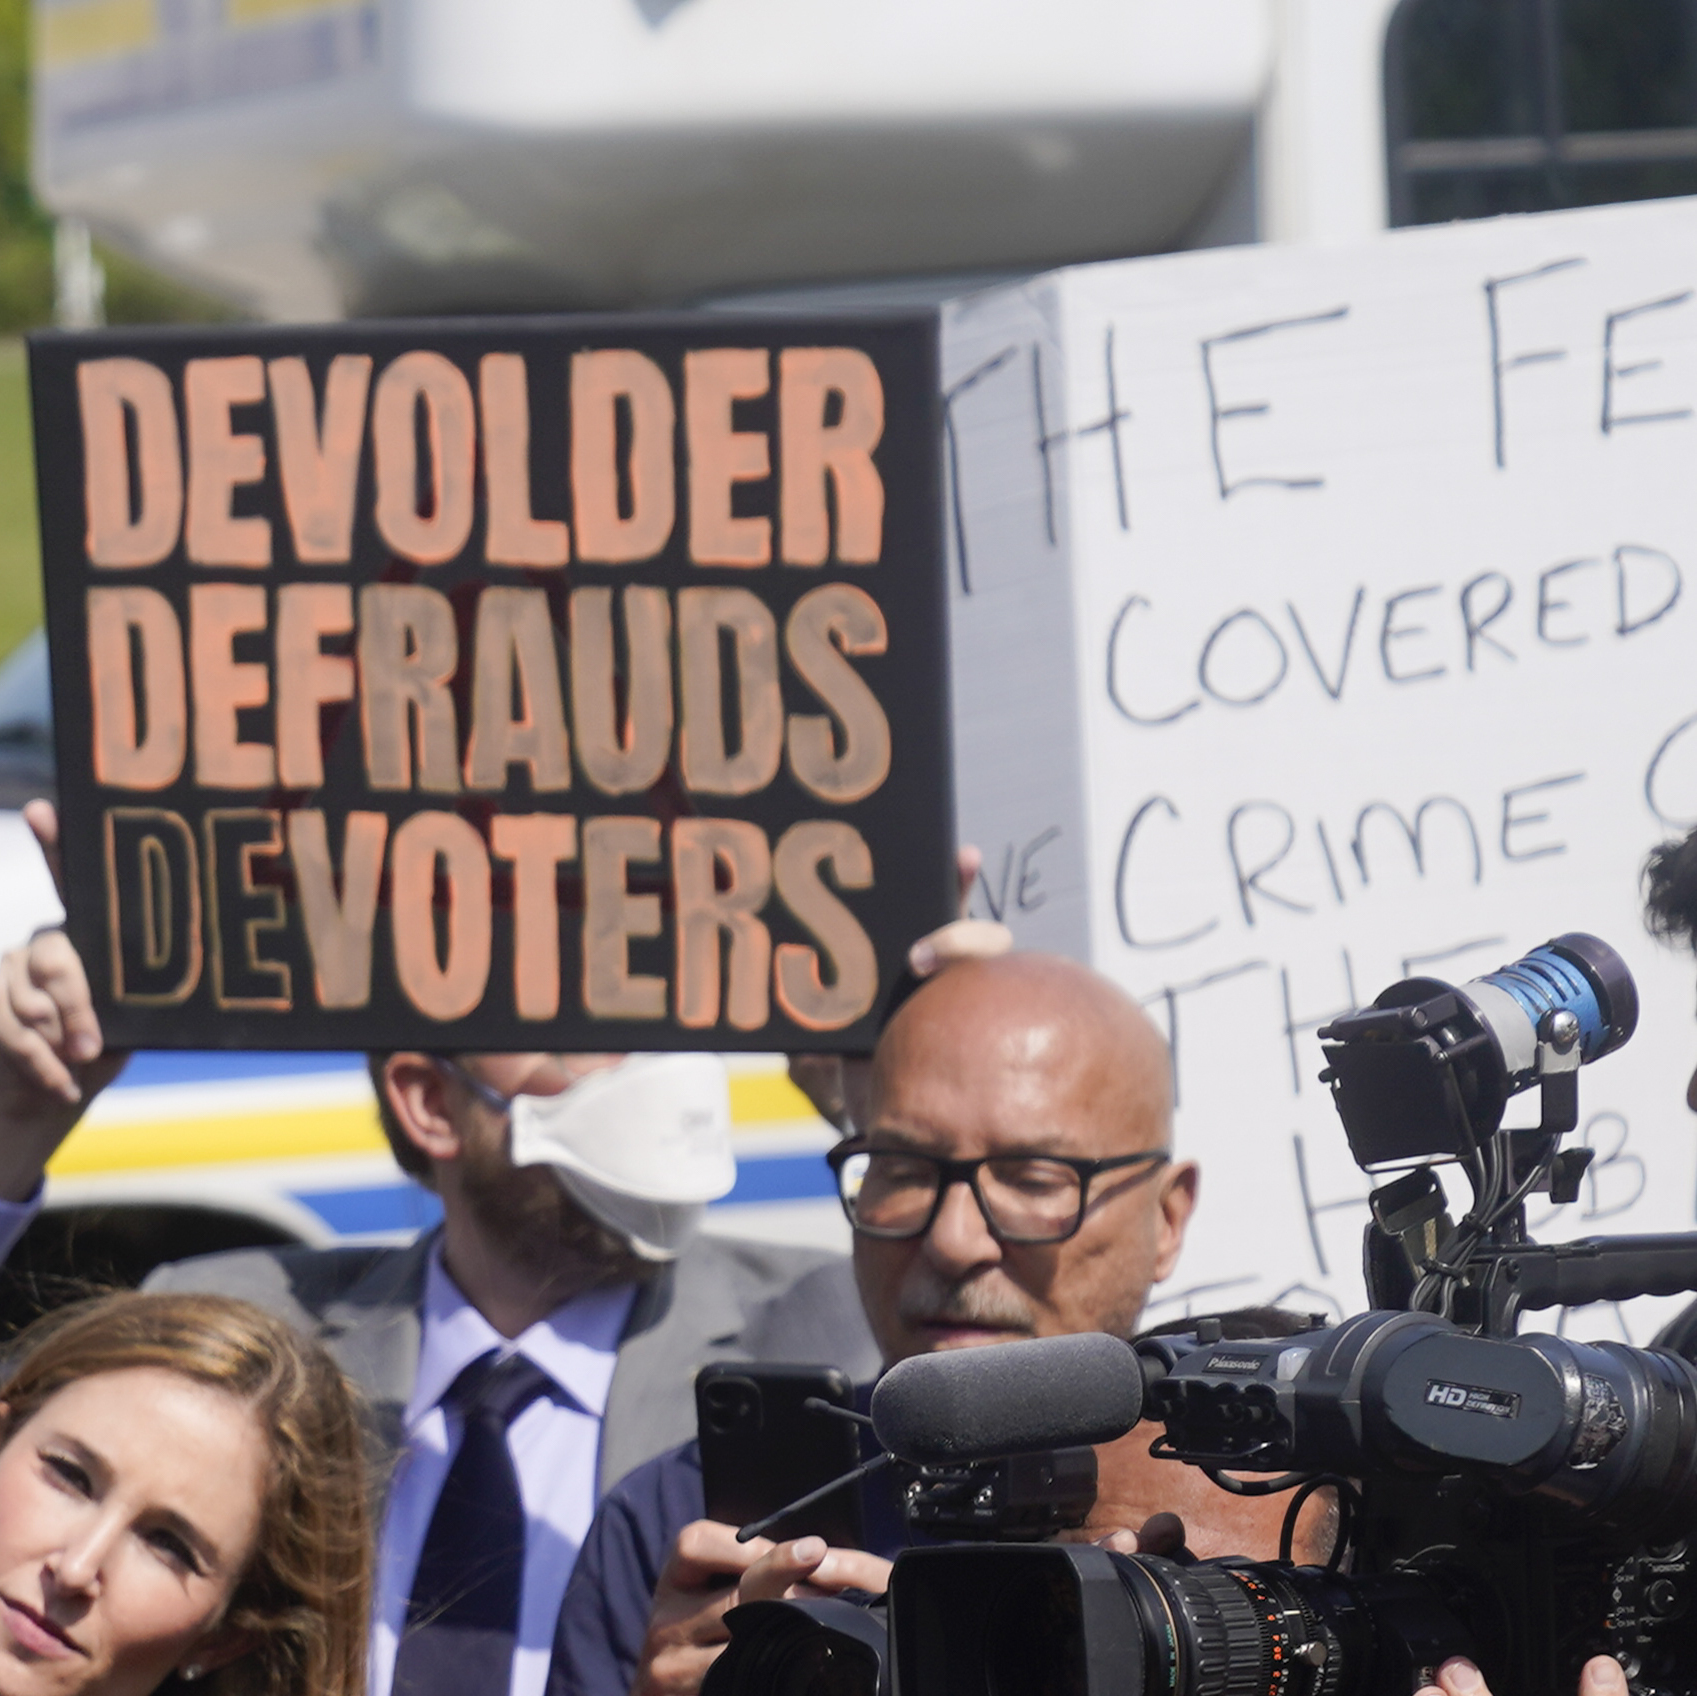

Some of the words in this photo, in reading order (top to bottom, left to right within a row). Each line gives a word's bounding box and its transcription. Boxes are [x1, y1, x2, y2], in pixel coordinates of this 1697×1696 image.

[76, 347, 885, 568] DEVOLDER
[943, 304, 1350, 597] THE
[86, 582, 892, 802] DEFRAUDS
[1107, 543, 1683, 727] COVERED
[103, 808, 879, 1031] DEVOTERS
[1114, 772, 1587, 949] CRIME
[1428, 1384, 1467, 1407] HD
